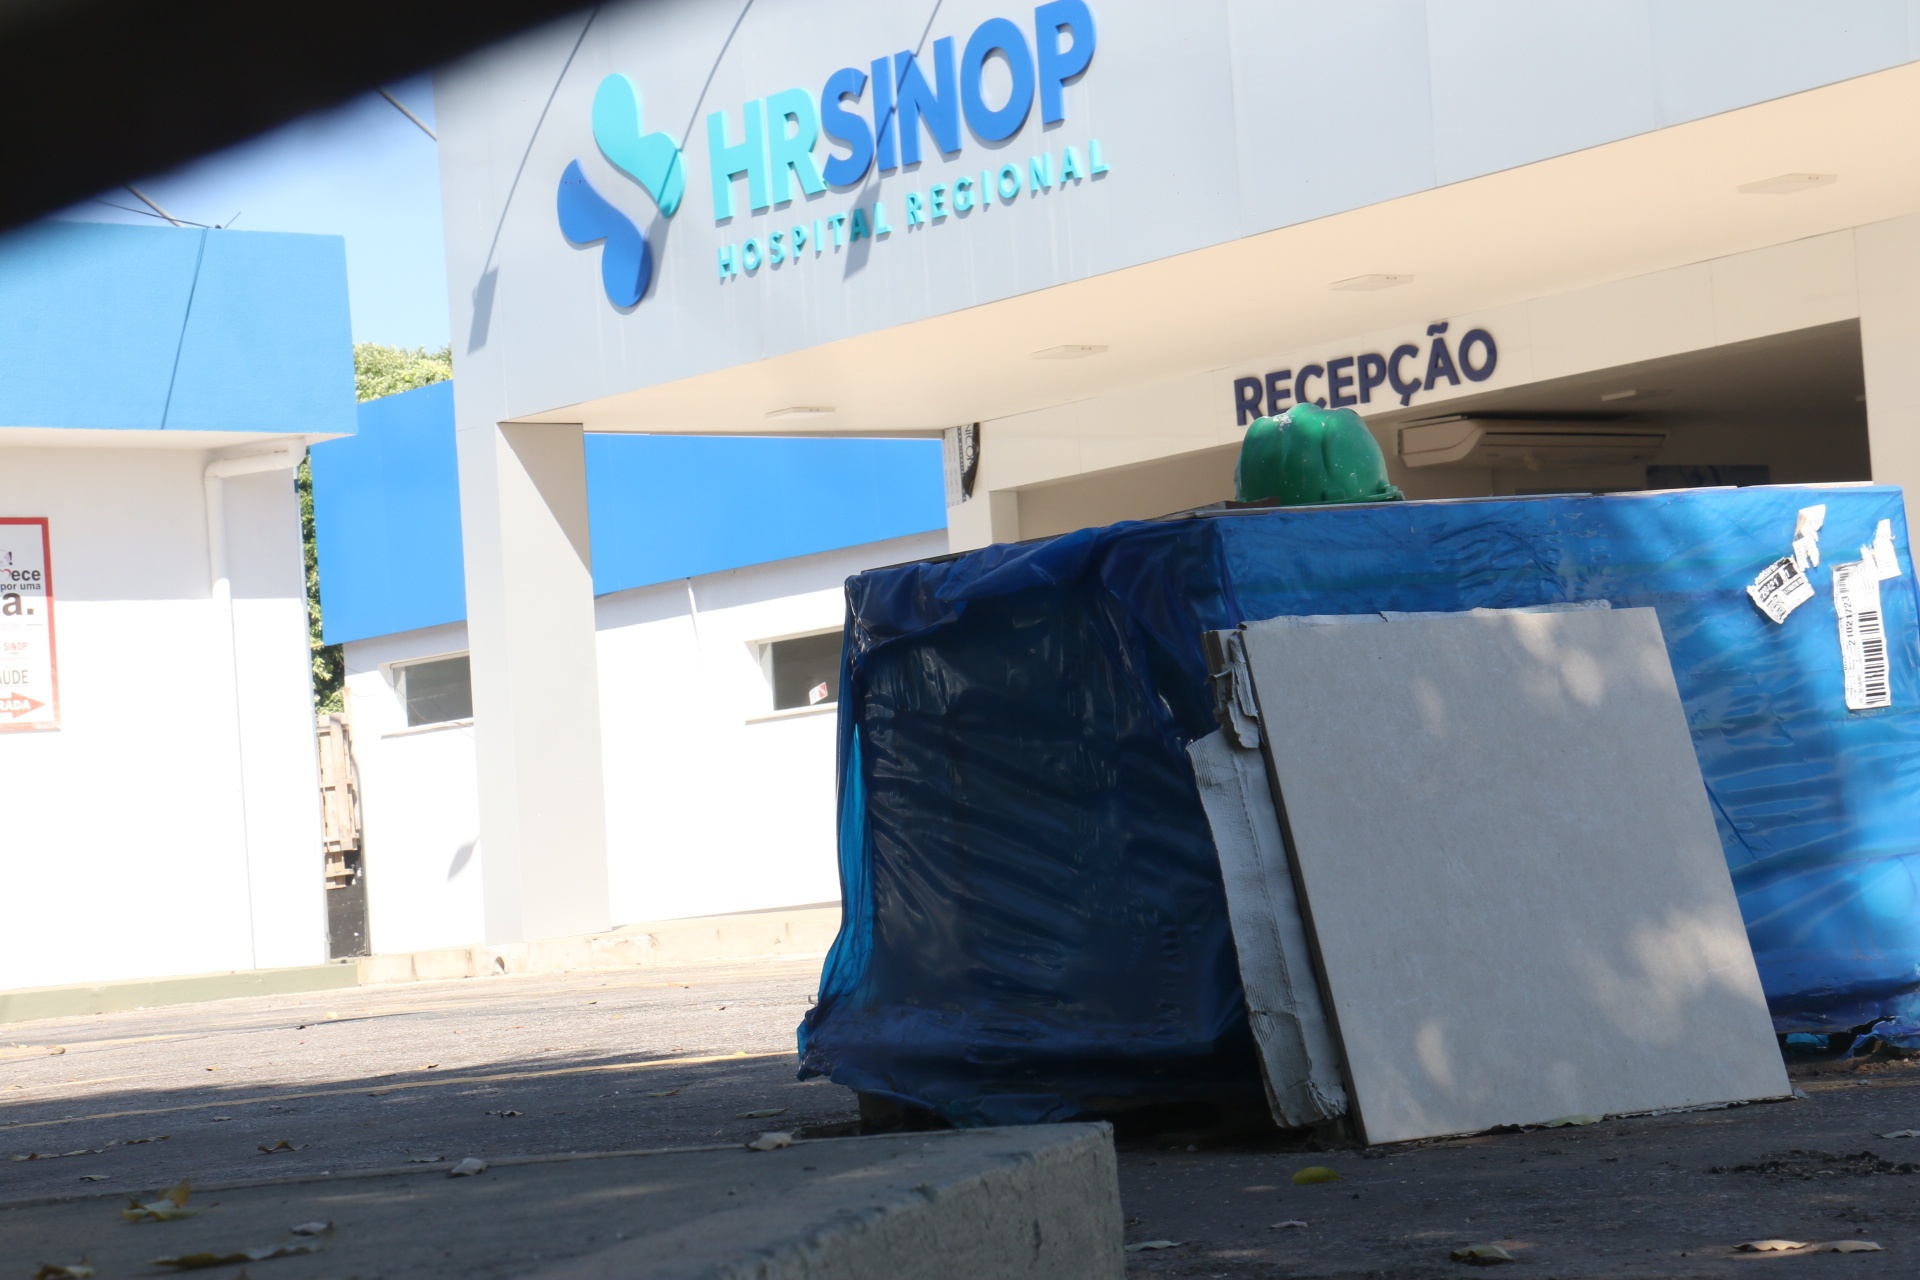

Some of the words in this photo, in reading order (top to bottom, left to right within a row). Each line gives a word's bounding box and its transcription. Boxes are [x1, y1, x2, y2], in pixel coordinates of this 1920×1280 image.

[706, 0, 1097, 221] HRSINOP
[717, 202, 892, 279] HOSPITAL
[906, 139, 1110, 226] REGIONAL
[1233, 322, 1498, 426] RECEPÇÃO
[0, 583, 17, 593] por
[20, 583, 41, 591] uma
[3, 642, 28, 651] SINOP
